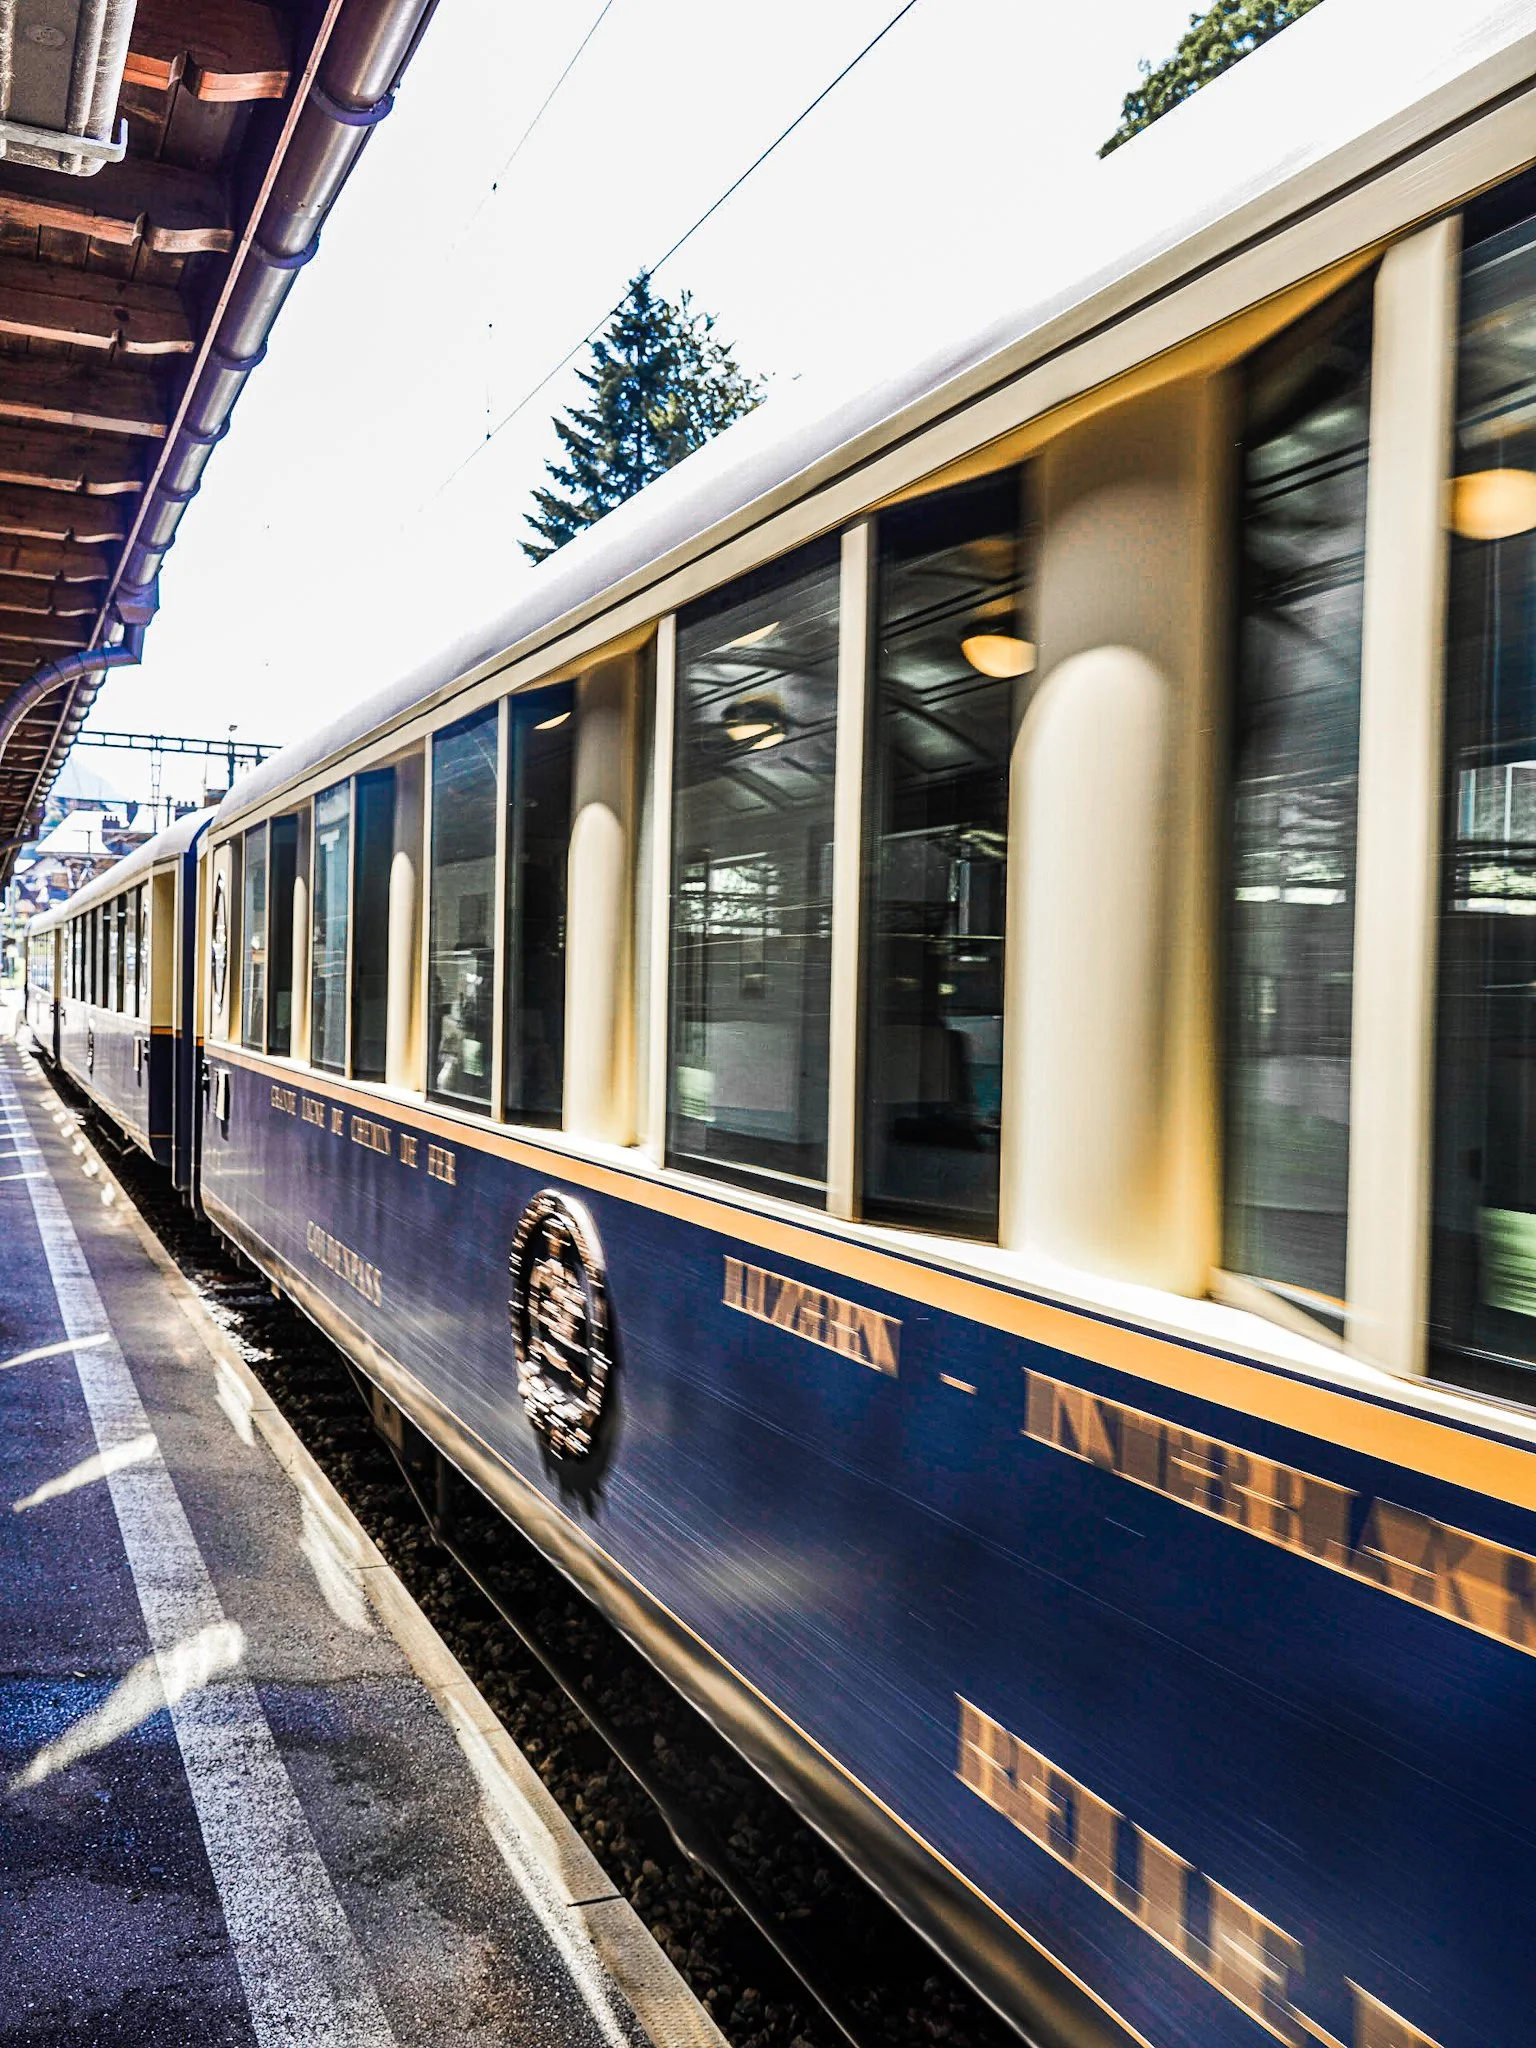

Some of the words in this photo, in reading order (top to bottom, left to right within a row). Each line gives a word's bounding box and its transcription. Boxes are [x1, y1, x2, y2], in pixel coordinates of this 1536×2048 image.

[331, 1107, 345, 1136] DE
[399, 1132, 419, 1169] DE
[427, 1143, 457, 1186] FER
[721, 1253, 904, 1379] LUZERN
